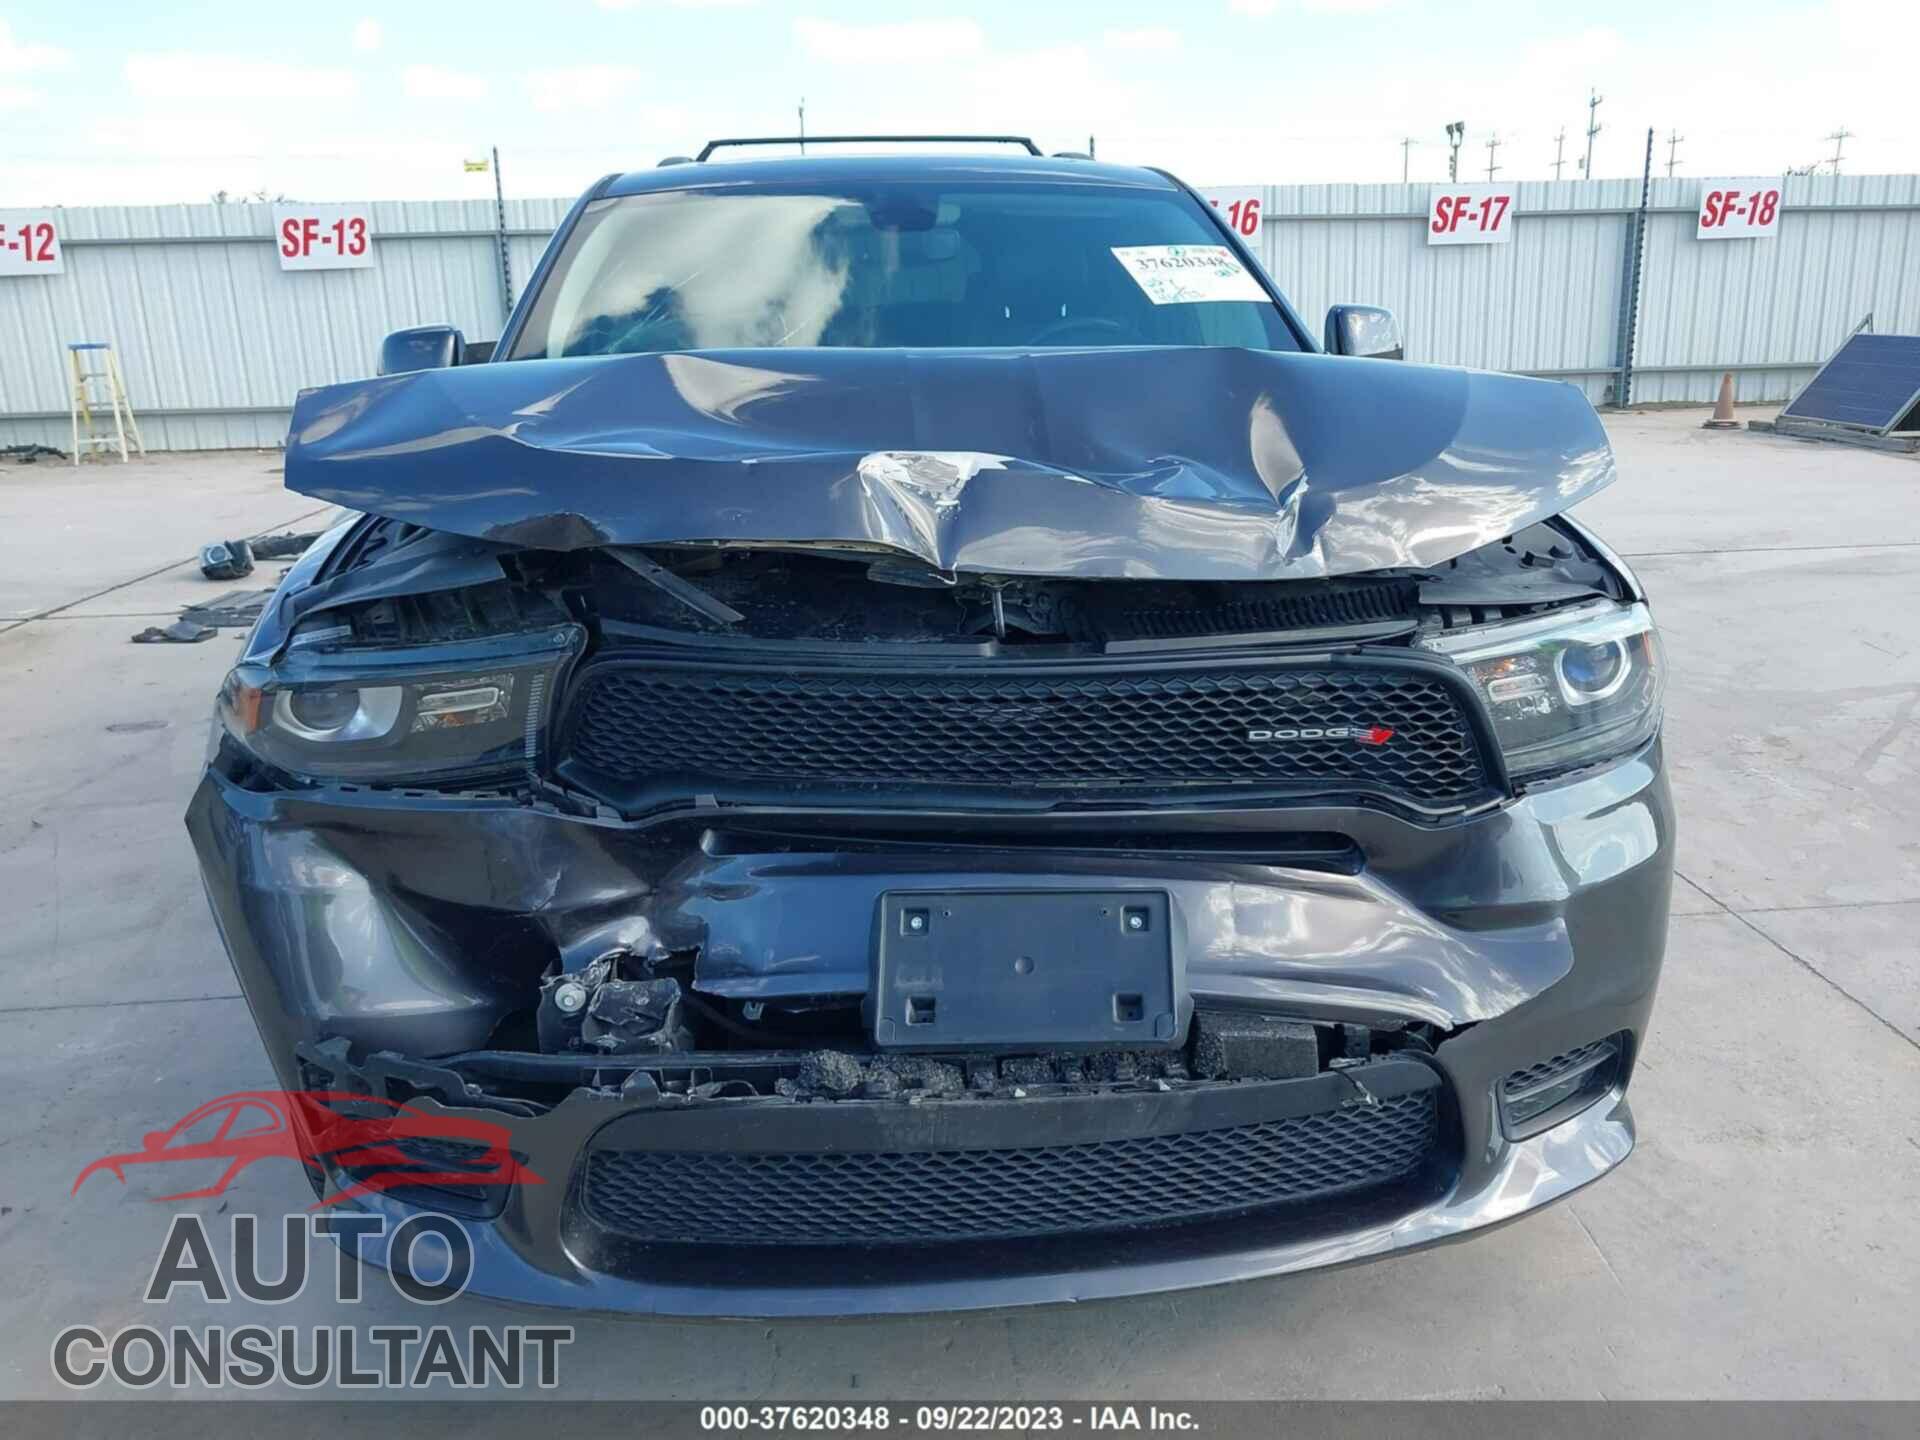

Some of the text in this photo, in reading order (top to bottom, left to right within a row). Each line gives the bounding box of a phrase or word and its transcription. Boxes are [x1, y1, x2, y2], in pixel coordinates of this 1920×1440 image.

[1210, 199, 1260, 235] 16
[1432, 195, 1511, 233] SF-17
[1700, 190, 1778, 229] SF-18
[281, 217, 367, 258] SF-13
[1249, 727, 1374, 741] DODGE
